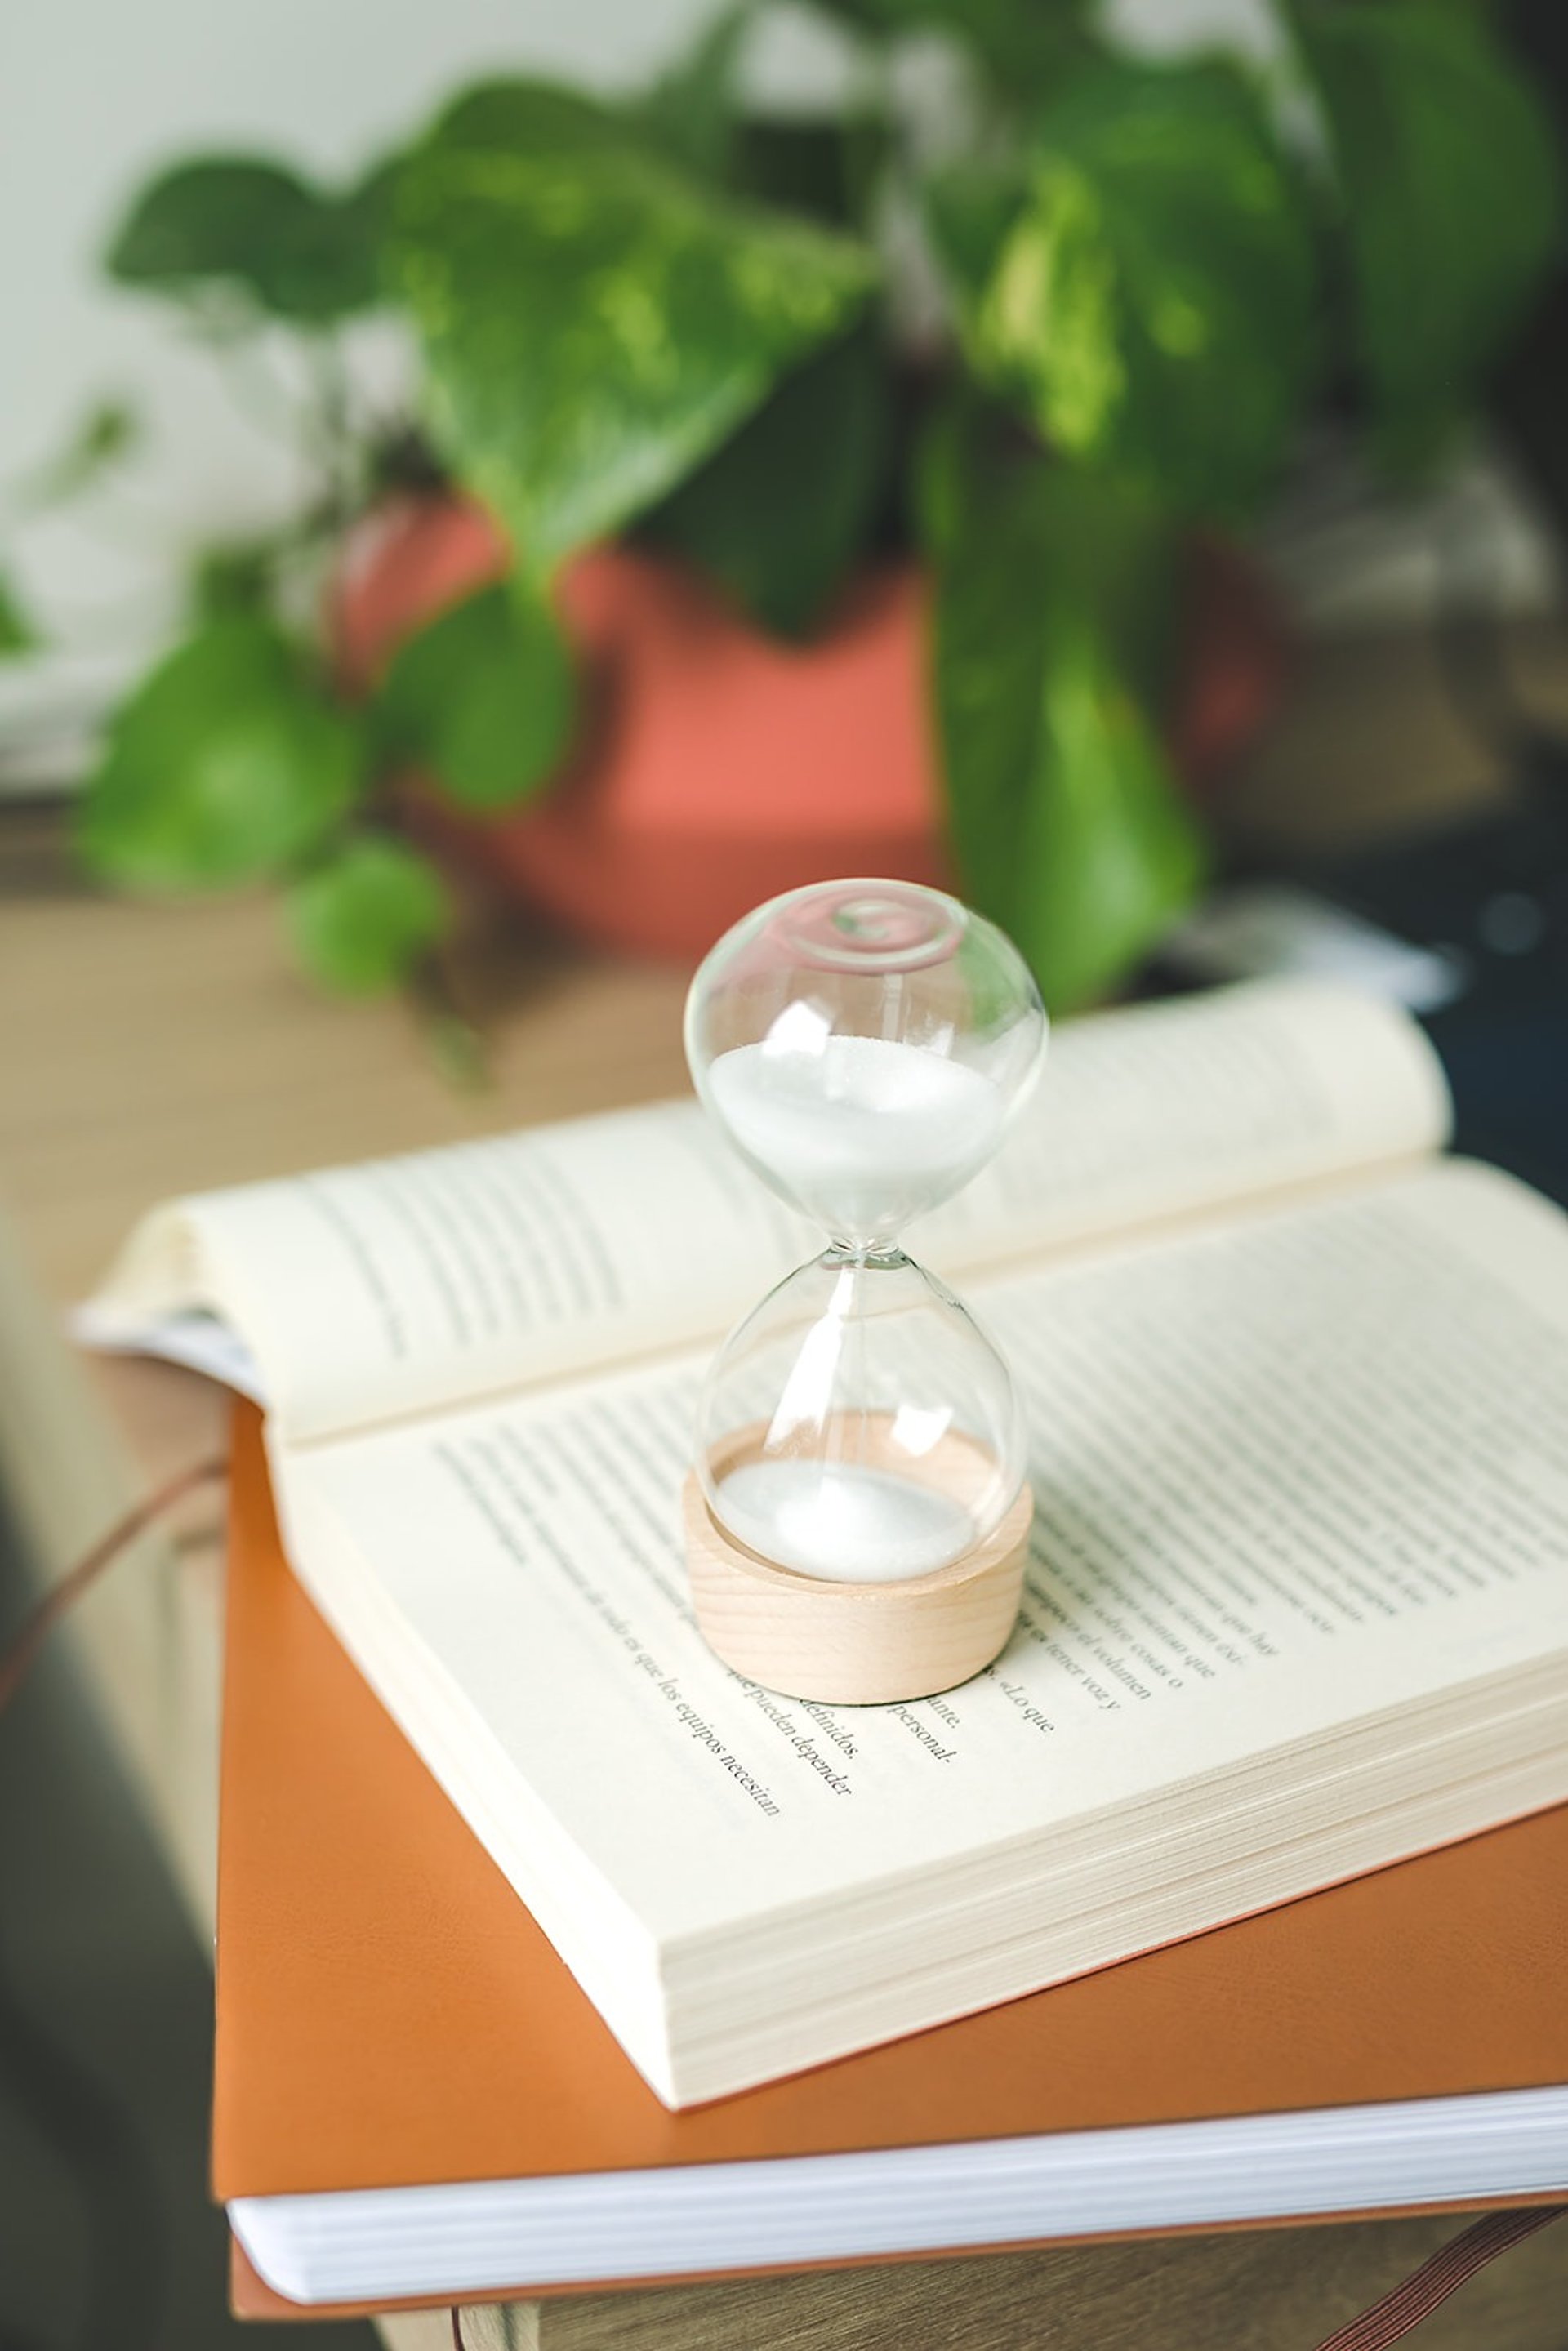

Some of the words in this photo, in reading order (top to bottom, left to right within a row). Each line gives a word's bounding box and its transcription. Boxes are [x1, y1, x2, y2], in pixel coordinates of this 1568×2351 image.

[1046, 1643, 1086, 1676] tener
[1080, 1676, 1111, 1701] voz
[1098, 1699, 1122, 1710] y
[1076, 1633, 1102, 1648] el
[1093, 1646, 1152, 1700] volumen
[1129, 1643, 1172, 1677] cosas
[1168, 1677, 1184, 1689] o
[1183, 1654, 1216, 1680] que
[634, 1651, 665, 1679] que
[657, 1677, 683, 1702] los
[675, 1701, 726, 1755] equipos
[719, 1753, 781, 1818] necesitan
[799, 1698, 859, 1760] definidos.
[887, 1703, 958, 1765] personal-
[999, 1680, 1029, 1708] «Lo
[1022, 1706, 1056, 1734] que
[744, 1688, 797, 1737] pueden
[791, 1737, 853, 1797] depender
